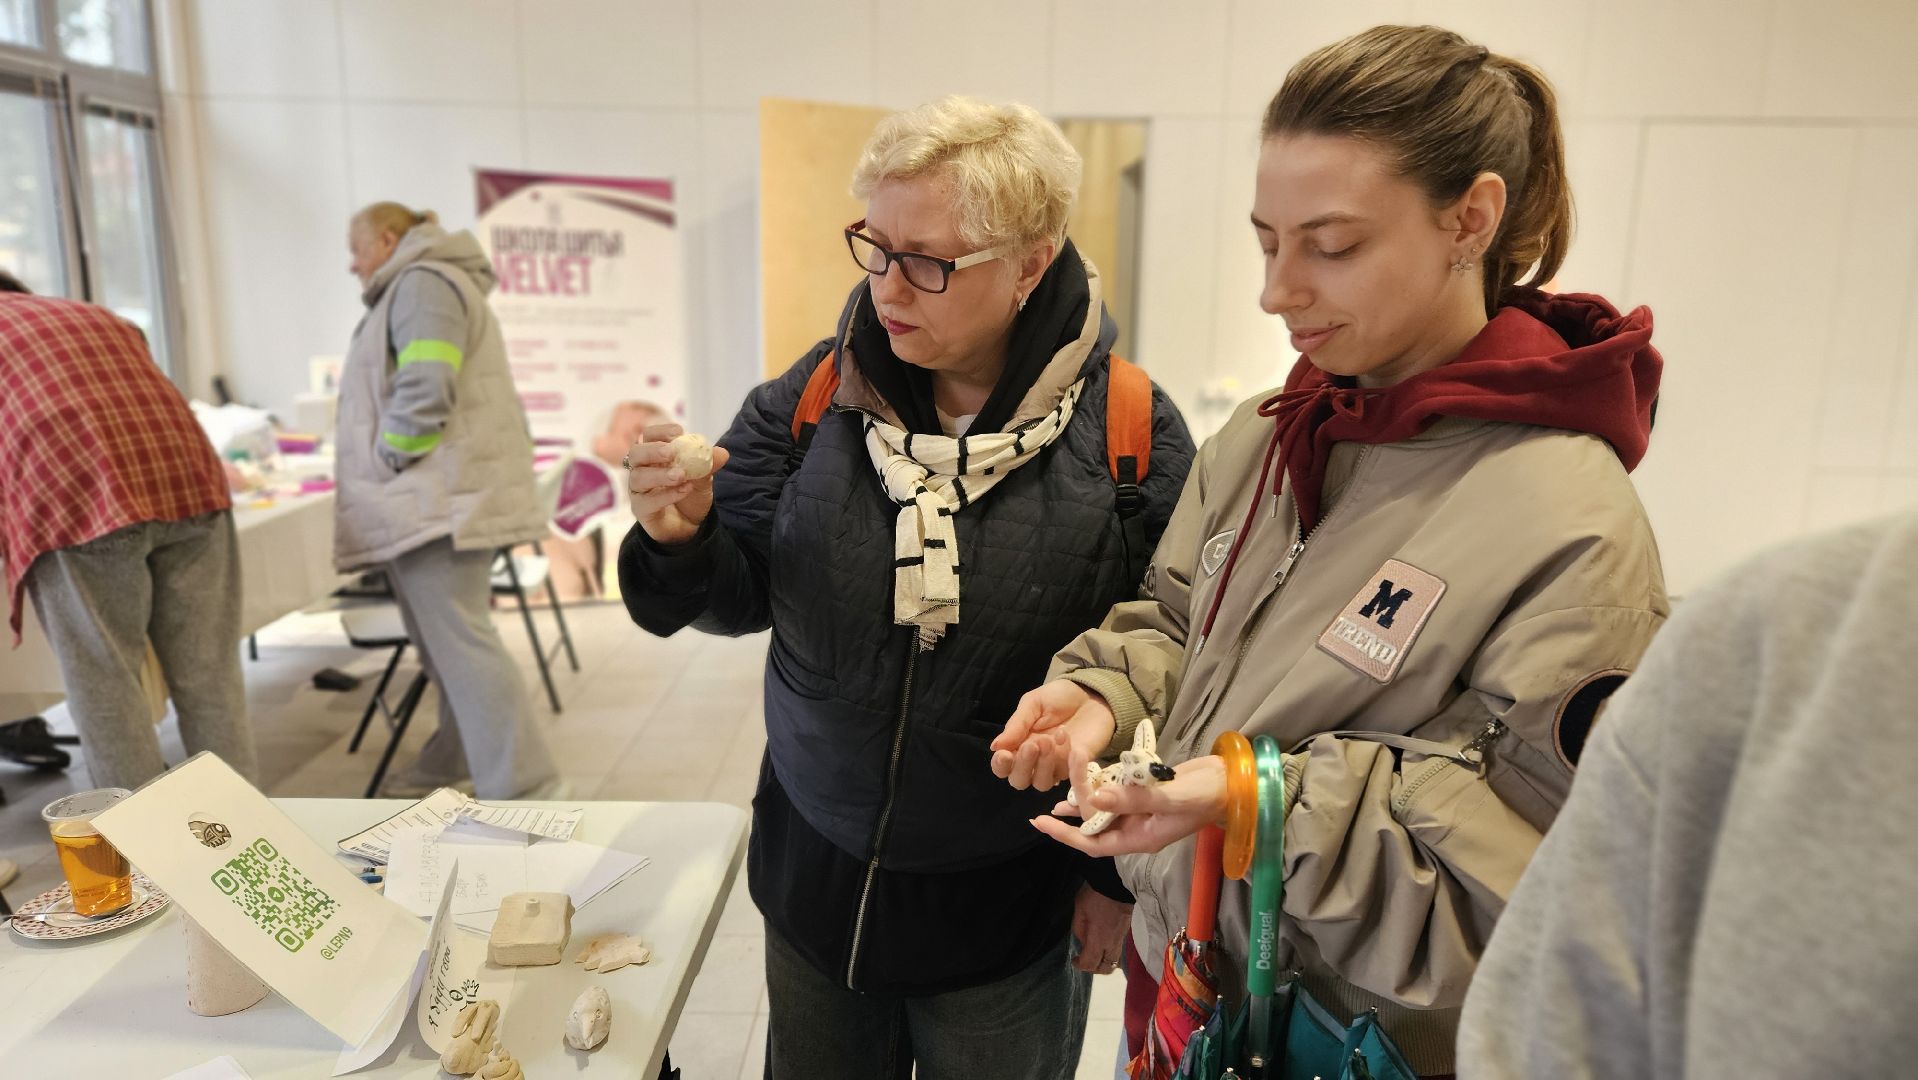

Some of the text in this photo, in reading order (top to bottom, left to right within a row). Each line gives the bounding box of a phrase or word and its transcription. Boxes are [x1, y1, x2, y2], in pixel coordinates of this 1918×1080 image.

[490, 225, 558, 253] ШКОЛА
[493, 254, 593, 296] VELVET
[1358, 579, 1414, 629] M
[1330, 616, 1397, 665] TREND
[320, 926, 353, 960] @LEPN9
